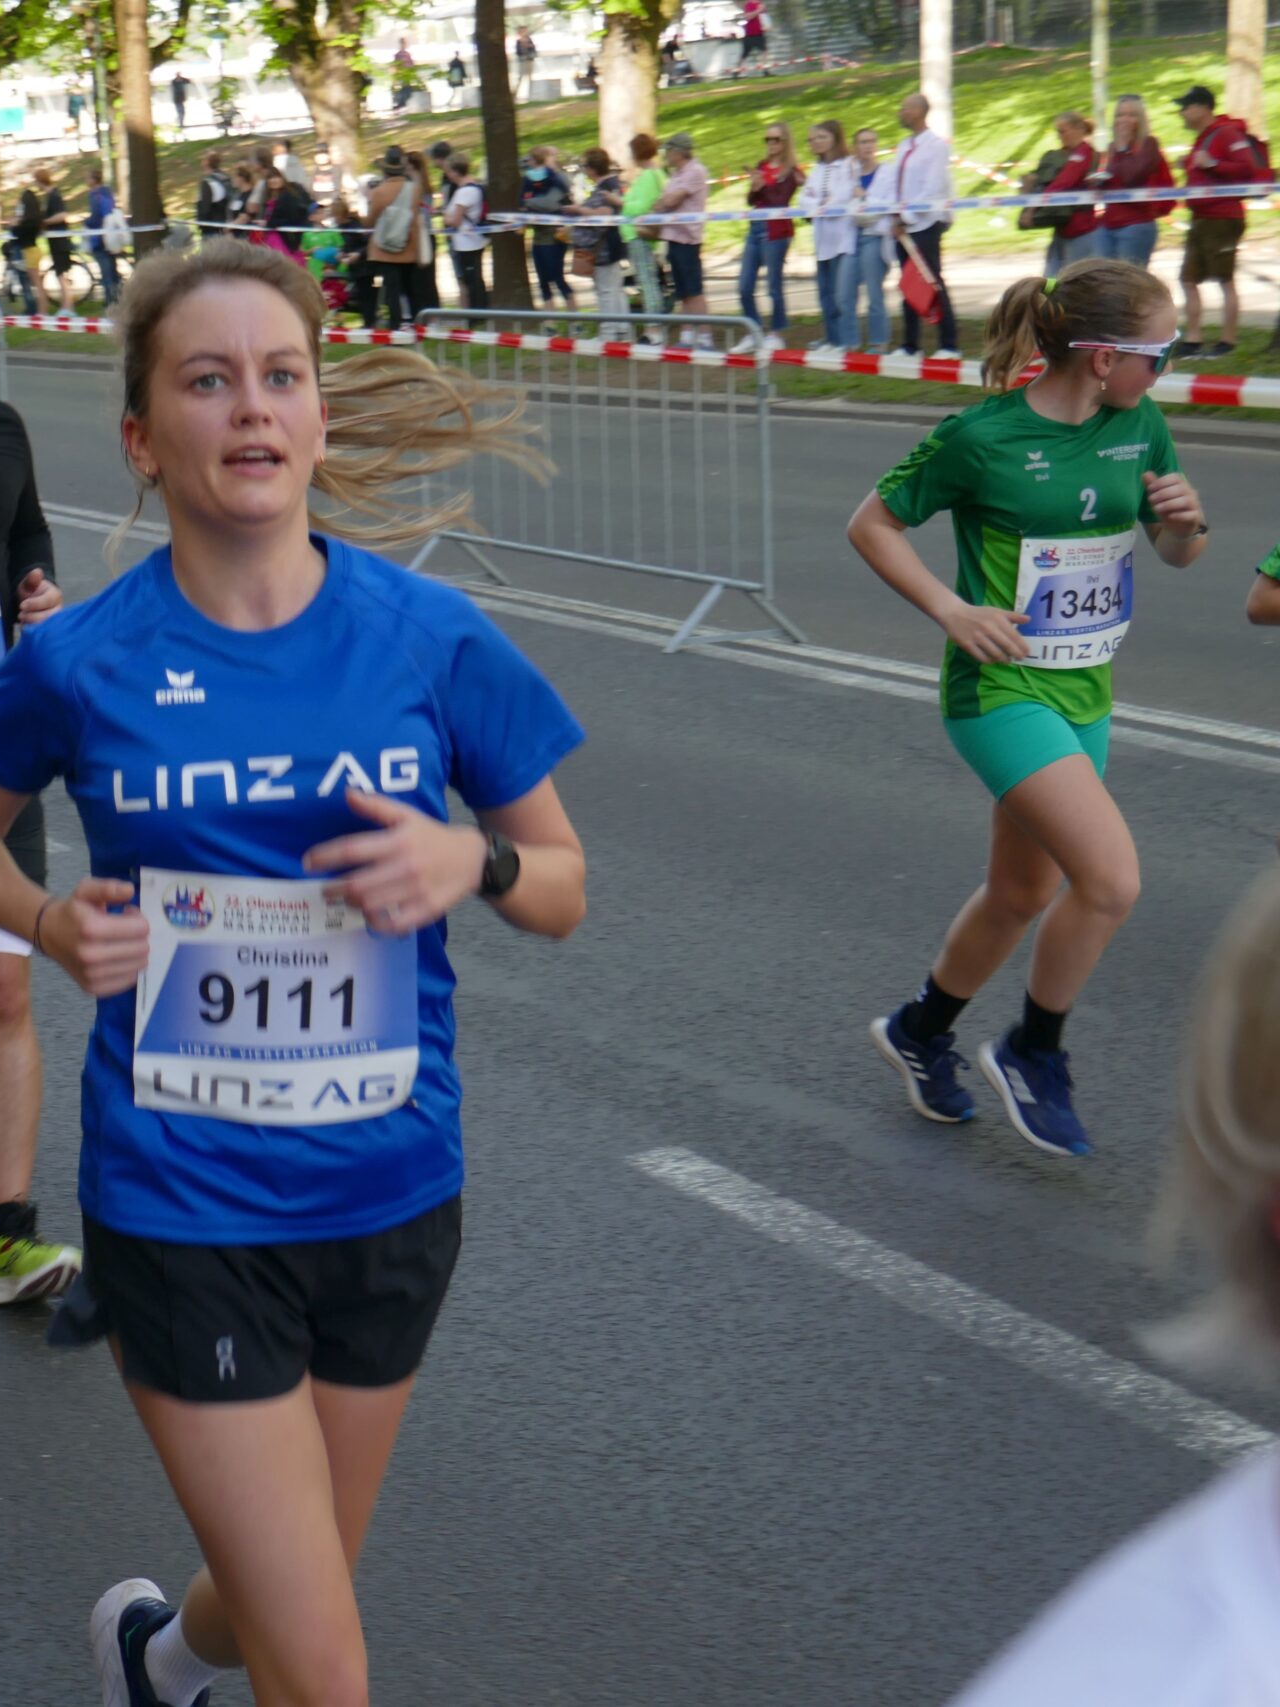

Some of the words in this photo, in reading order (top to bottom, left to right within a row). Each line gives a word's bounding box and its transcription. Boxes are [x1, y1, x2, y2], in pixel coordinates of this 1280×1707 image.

[1079, 487, 1098, 522] 2
[1039, 582, 1123, 619] 13434
[155, 687, 206, 706] erima
[113, 755, 295, 814] LINZ
[317, 746, 419, 798] AG
[237, 944, 329, 968] Christina
[198, 971, 355, 1032] 9111
[153, 1068, 295, 1110] LINZ
[311, 1073, 397, 1109] AG
